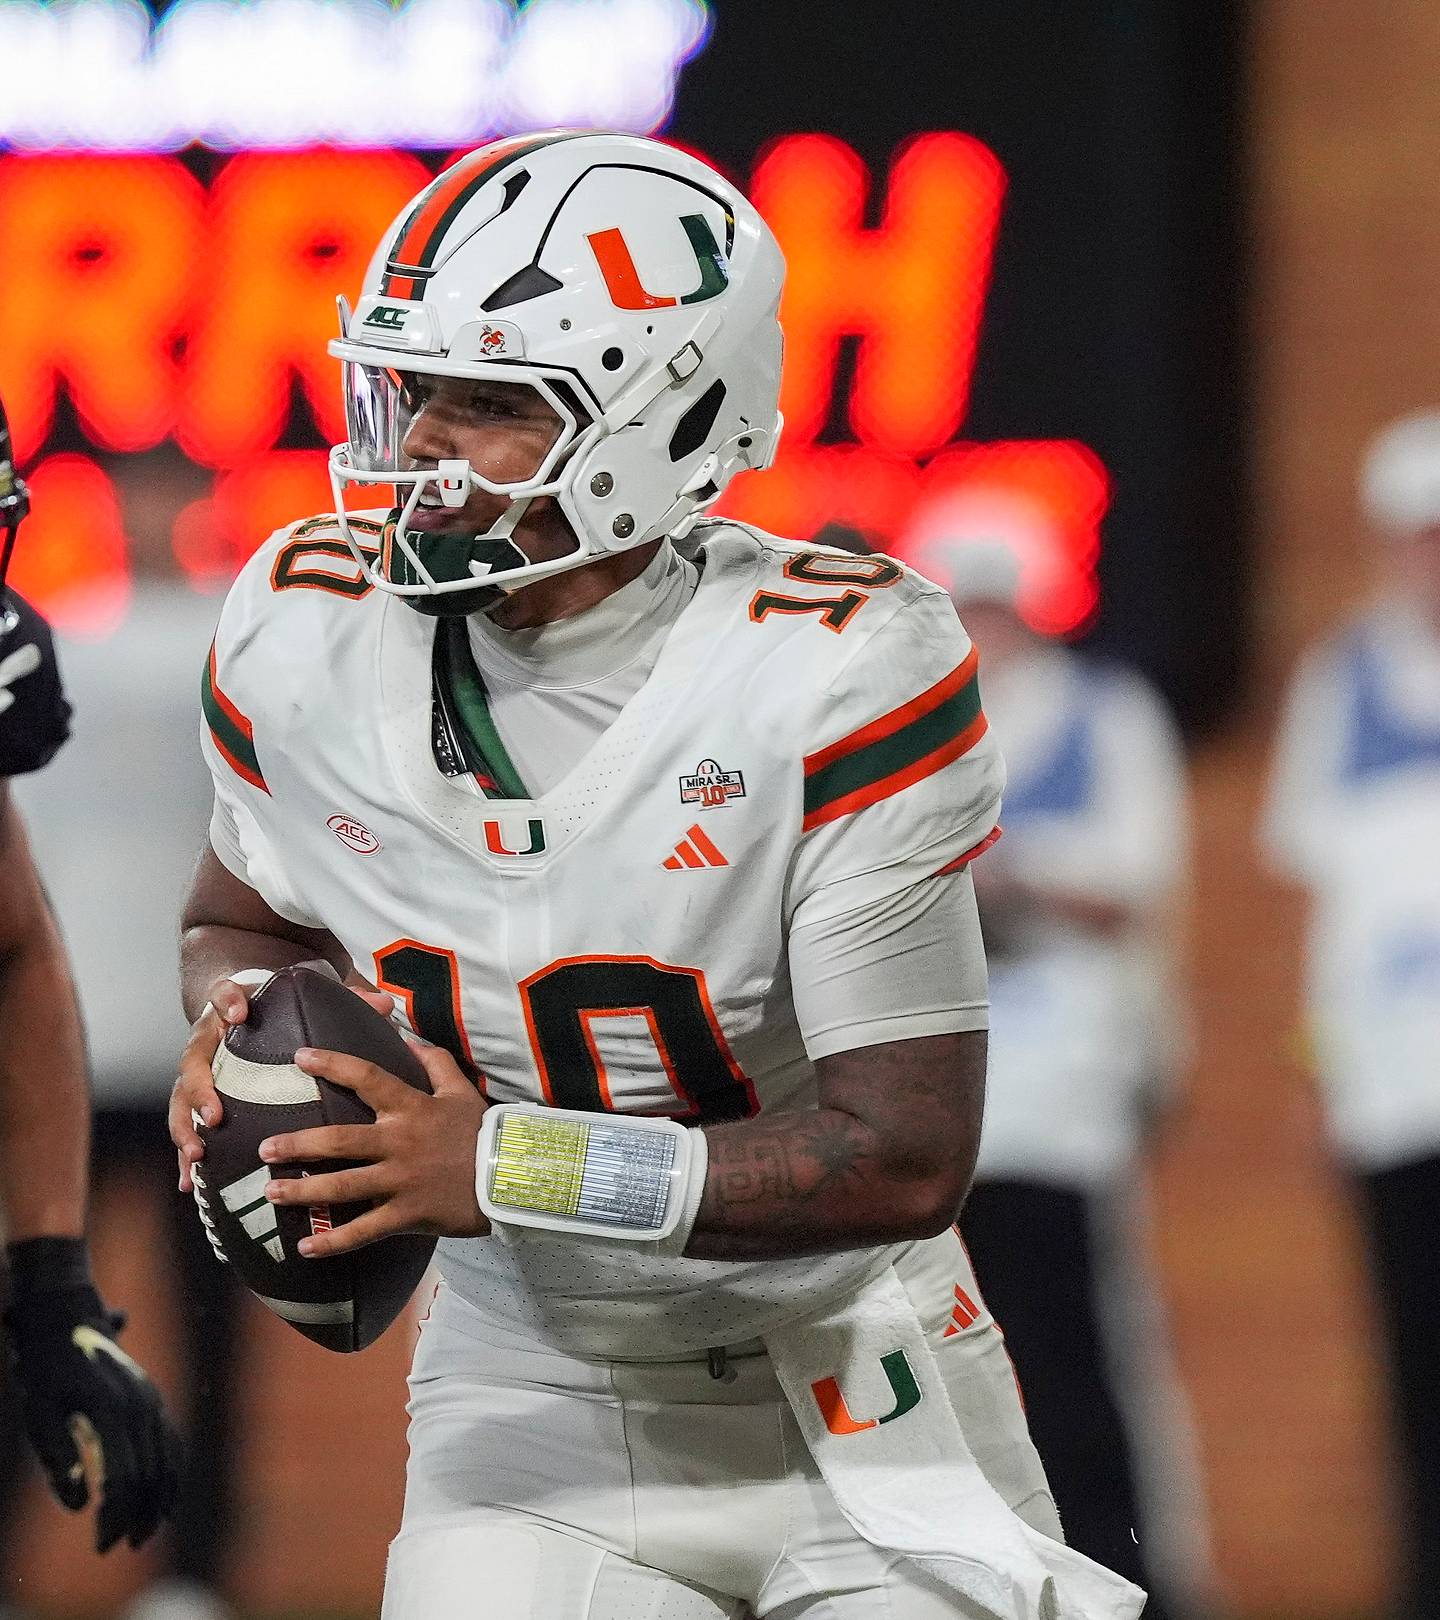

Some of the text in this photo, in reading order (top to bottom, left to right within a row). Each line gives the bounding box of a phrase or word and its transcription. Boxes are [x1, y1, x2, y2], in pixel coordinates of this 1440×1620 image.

[582, 212, 730, 312] U
[365, 305, 410, 326] ACC
[748, 551, 904, 635] 10
[687, 775, 734, 788] MIRA SR.
[700, 785, 725, 806] 10
[336, 823, 371, 843] ACC
[482, 818, 547, 856] U
[371, 937, 761, 1120] 10
[811, 1348, 922, 1436] U
